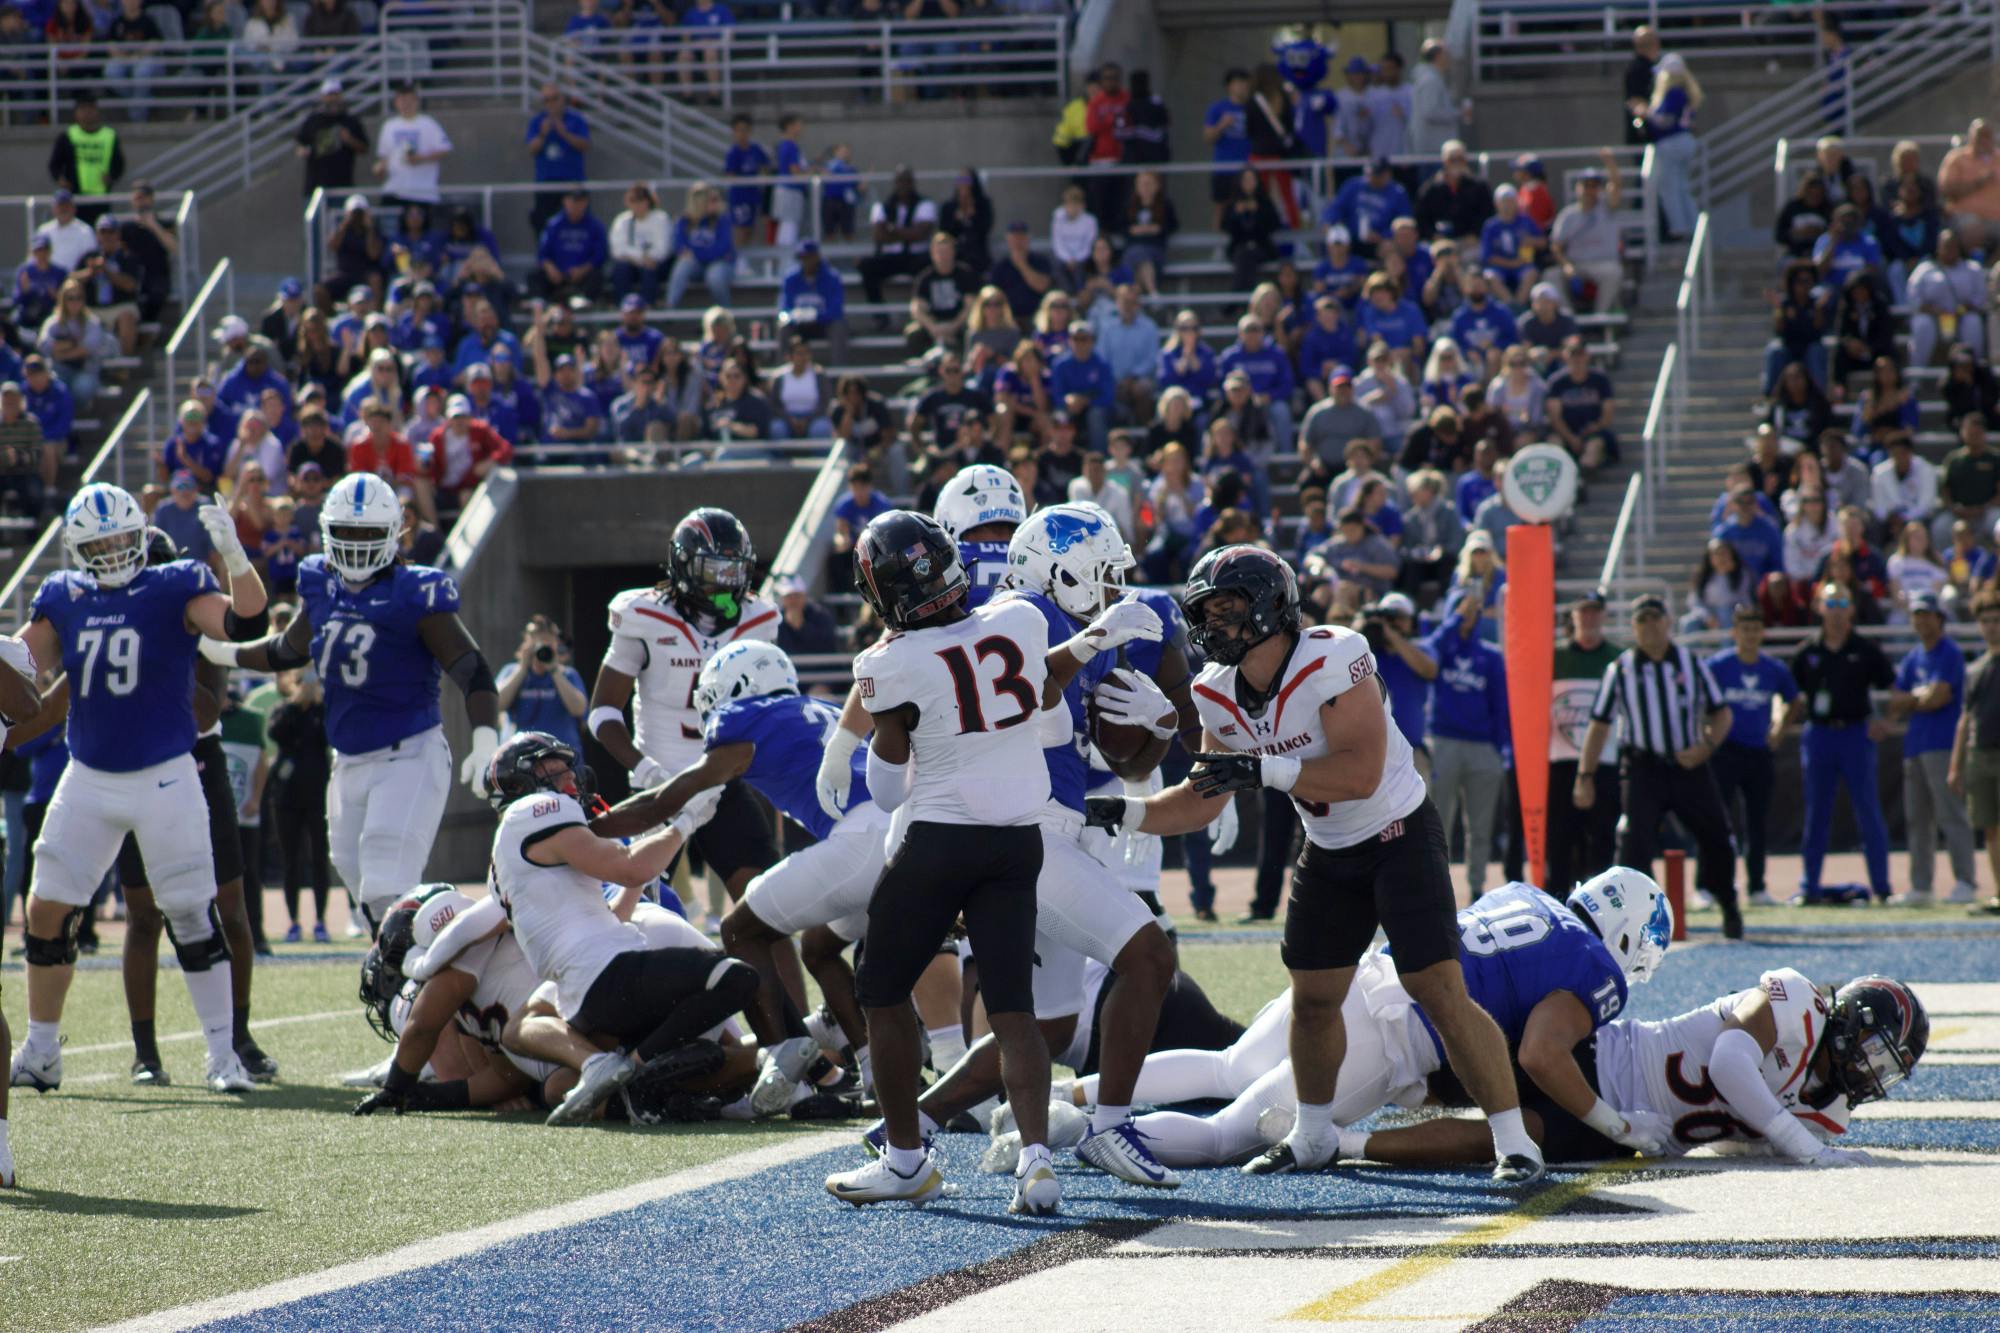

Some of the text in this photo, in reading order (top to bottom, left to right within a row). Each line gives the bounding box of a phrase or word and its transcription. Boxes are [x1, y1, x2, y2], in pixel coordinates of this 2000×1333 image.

[978, 508, 1020, 522] BUFFALO
[1017, 555, 1028, 565] GP
[420, 577, 460, 608] 73
[86, 614, 126, 627] BUFFALO
[76, 627, 141, 697] 79
[318, 620, 377, 688] 73
[670, 658, 703, 668] SAINT
[1349, 653, 1374, 684] SFU
[933, 634, 1039, 735] 13
[1264, 732, 1313, 756] FRANCIS
[1380, 818, 1405, 842] SFU
[429, 904, 455, 932] SFU
[1591, 975, 1621, 1020] 19
